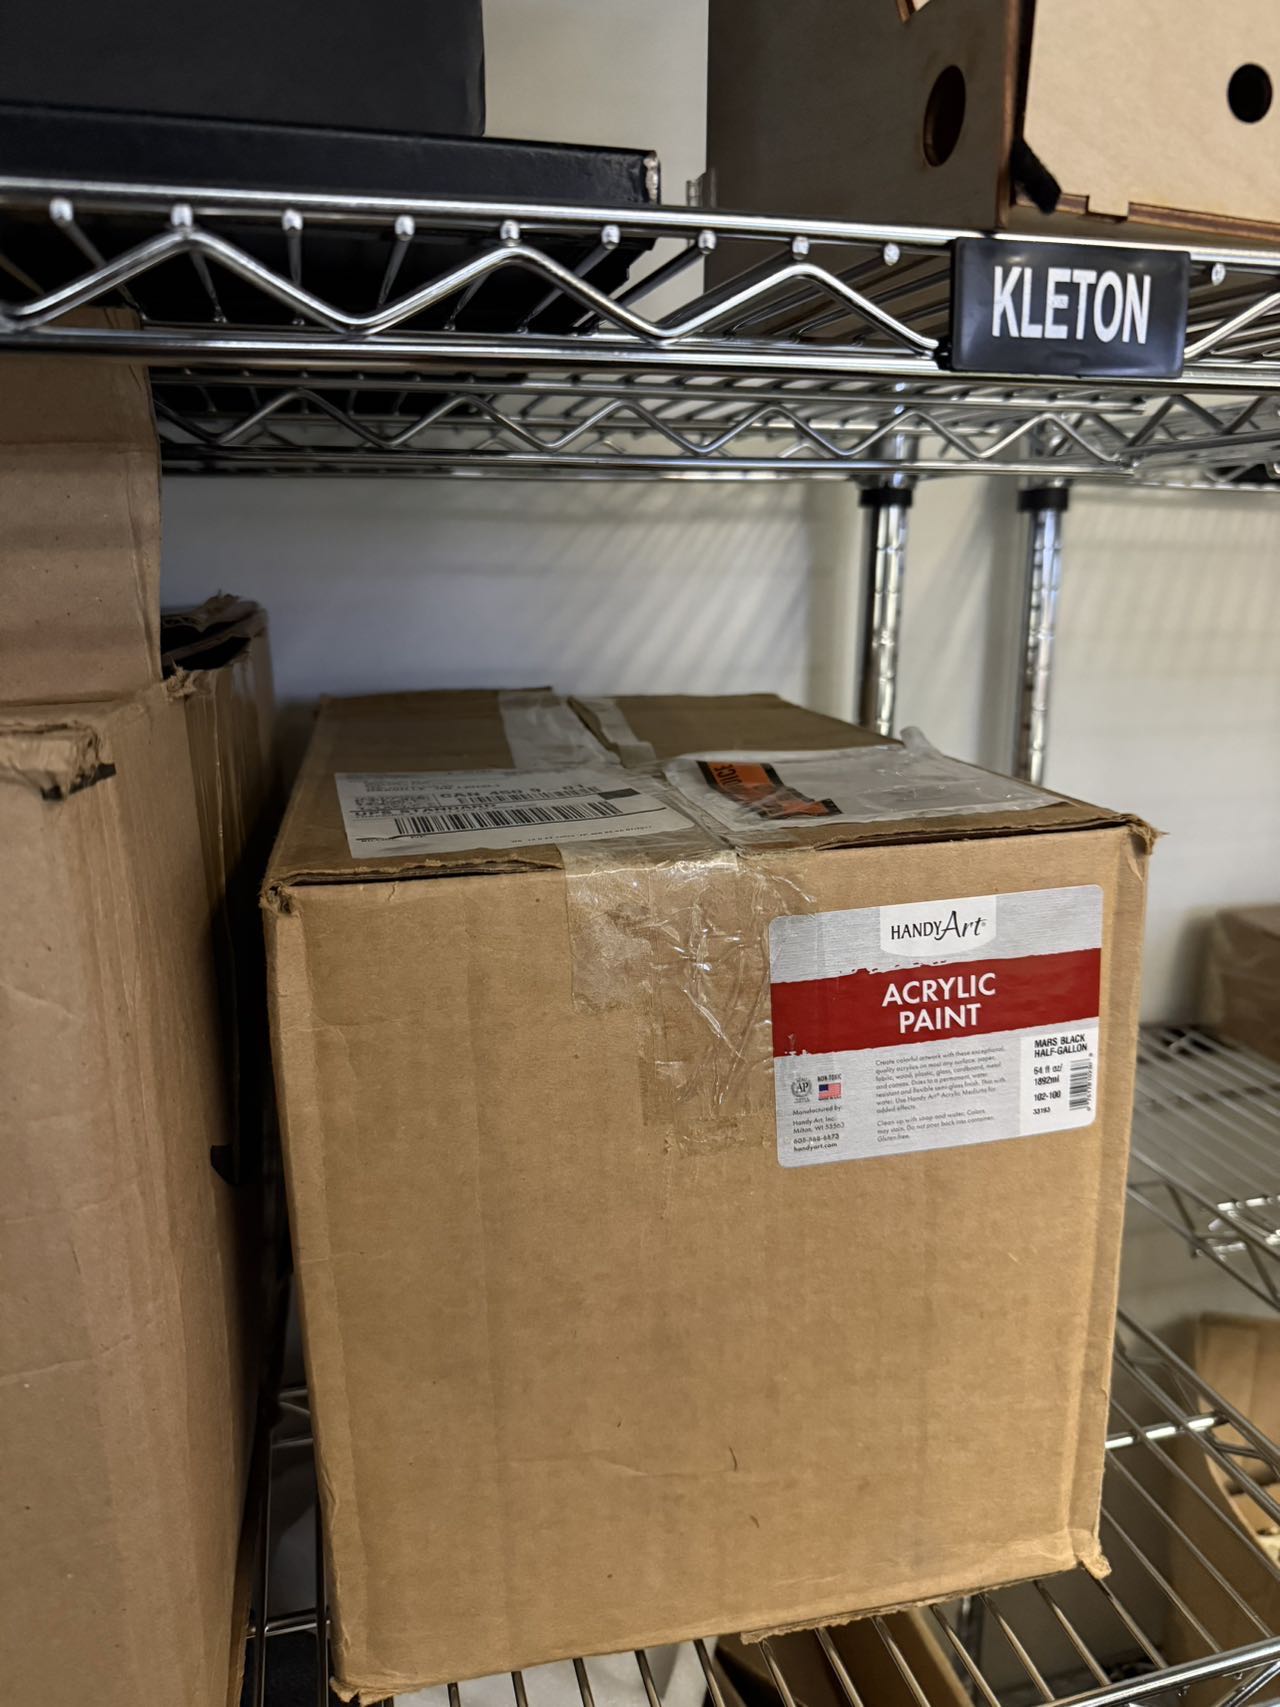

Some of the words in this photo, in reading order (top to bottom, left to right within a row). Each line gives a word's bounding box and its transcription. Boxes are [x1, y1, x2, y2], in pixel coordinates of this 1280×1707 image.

[992, 265, 1152, 345] KLETON
[881, 972, 997, 1007] ACRYLIC
[899, 1003, 983, 1034] PAINT
[1034, 1037, 1058, 1048] MARS
[1060, 1033, 1086, 1045] BLACK
[1034, 1043, 1088, 1058] HALF-GALLON
[896, 1055, 919, 1064] colorful
[875, 1066, 895, 1075] quality
[792, 1104, 834, 1116] Manufactured
[876, 1105, 896, 1113] added
[792, 1117, 813, 1127] Handy
[877, 1119, 895, 1127] Clean
[793, 1142, 838, 1152] handyart.com
